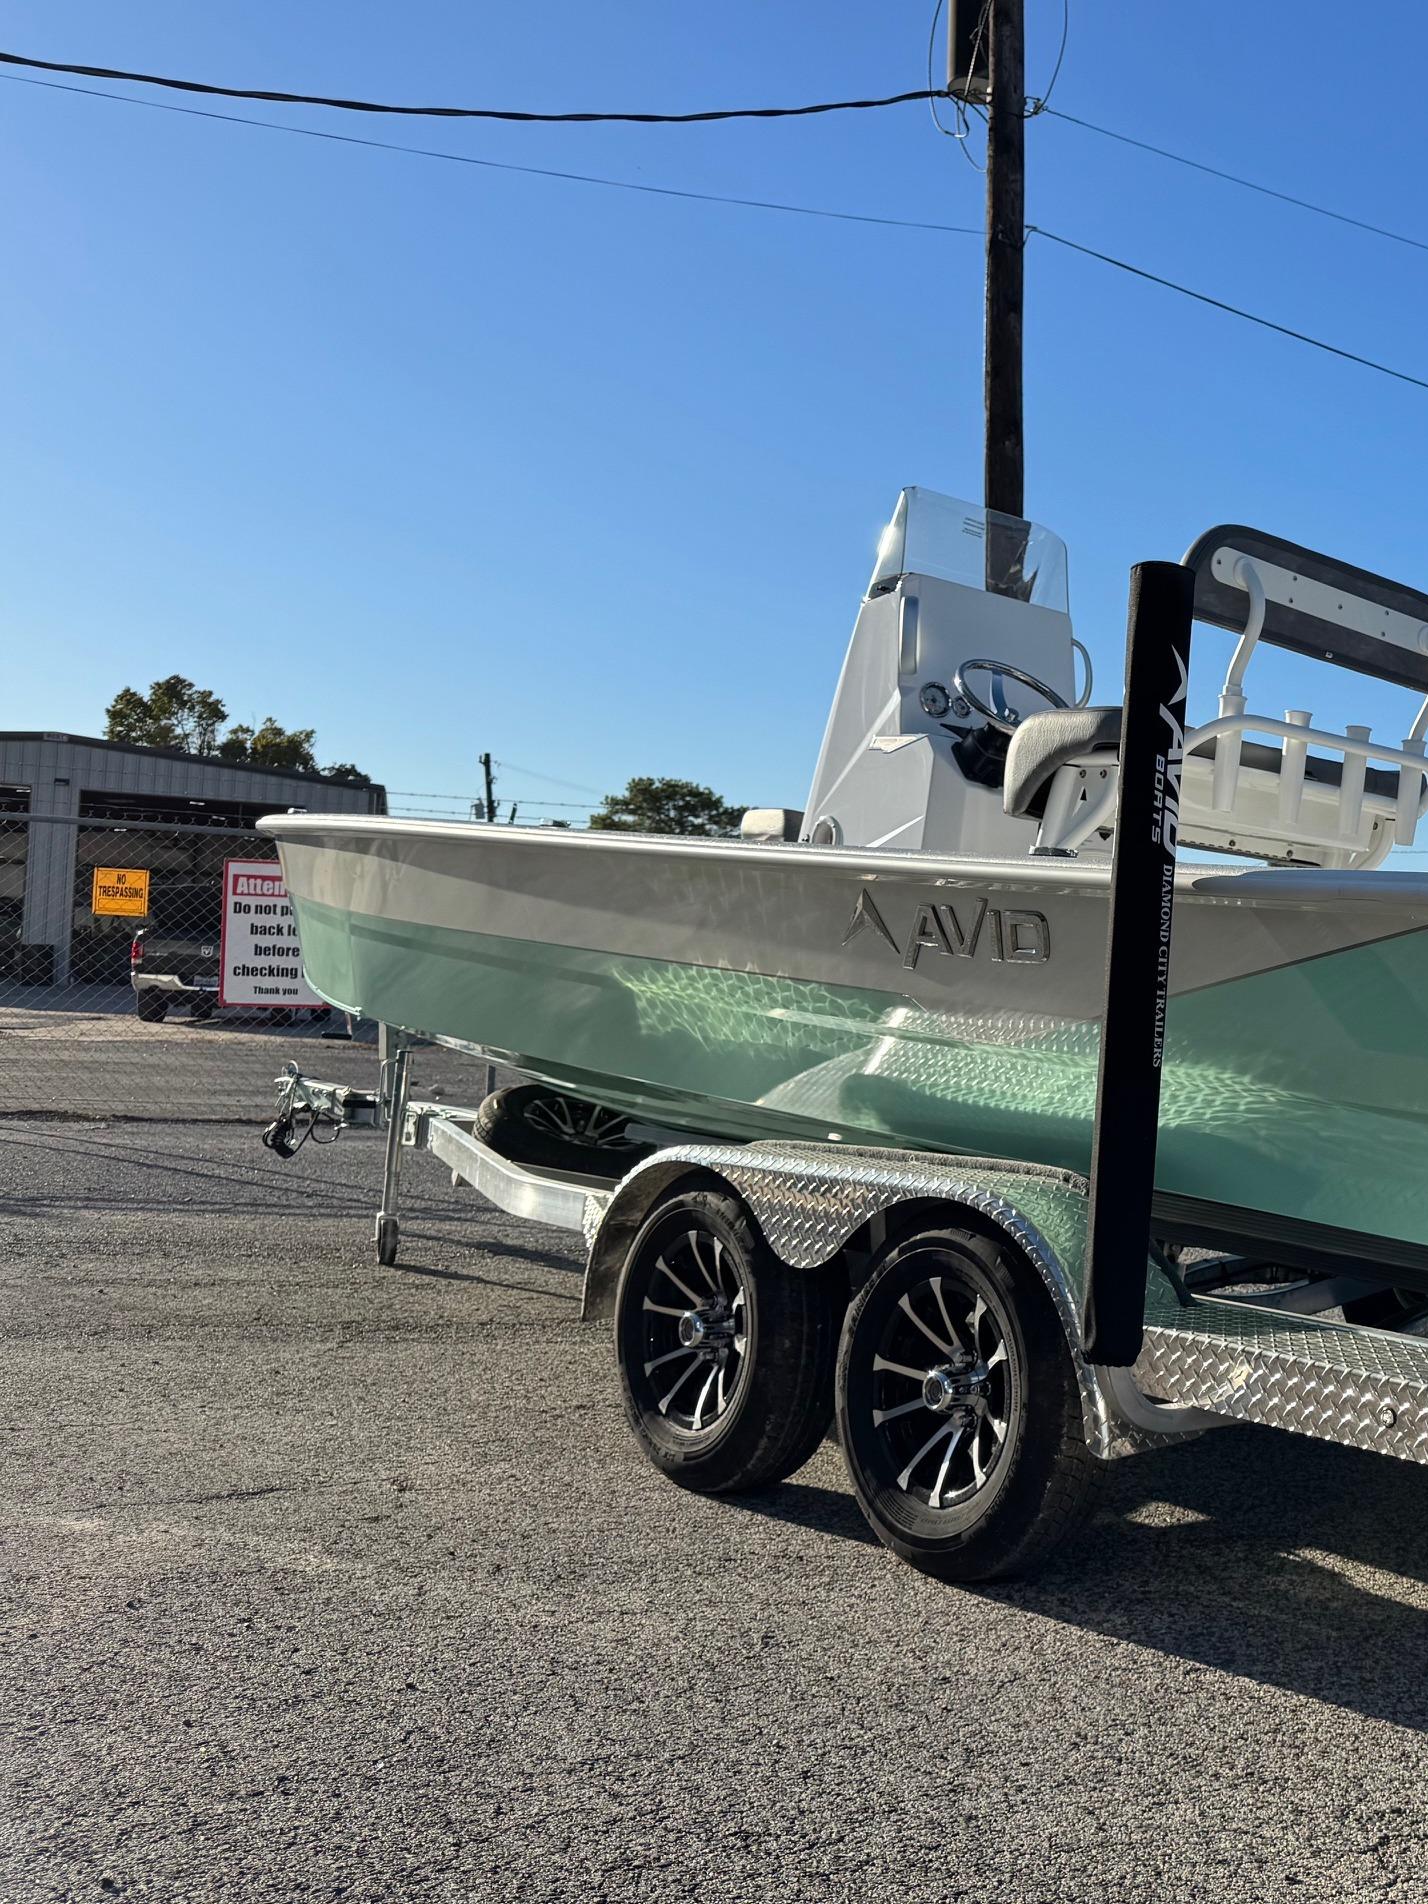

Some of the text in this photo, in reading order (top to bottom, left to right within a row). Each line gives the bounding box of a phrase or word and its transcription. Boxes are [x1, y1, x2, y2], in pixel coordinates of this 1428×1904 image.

[1158, 702, 1184, 860] AVID
[1152, 754, 1165, 845] BOATS
[116, 873, 127, 885] NO
[98, 885, 144, 899] TRESPASSING
[233, 901, 252, 914] Do
[254, 903, 278, 915] not
[250, 923, 284, 936] back
[903, 896, 1050, 970] AVID
[254, 944, 300, 957] before
[233, 964, 299, 979] checking
[1152, 864, 1174, 1068] DIAMOND CITY TRAILERS
[253, 985, 299, 996] Thank you
